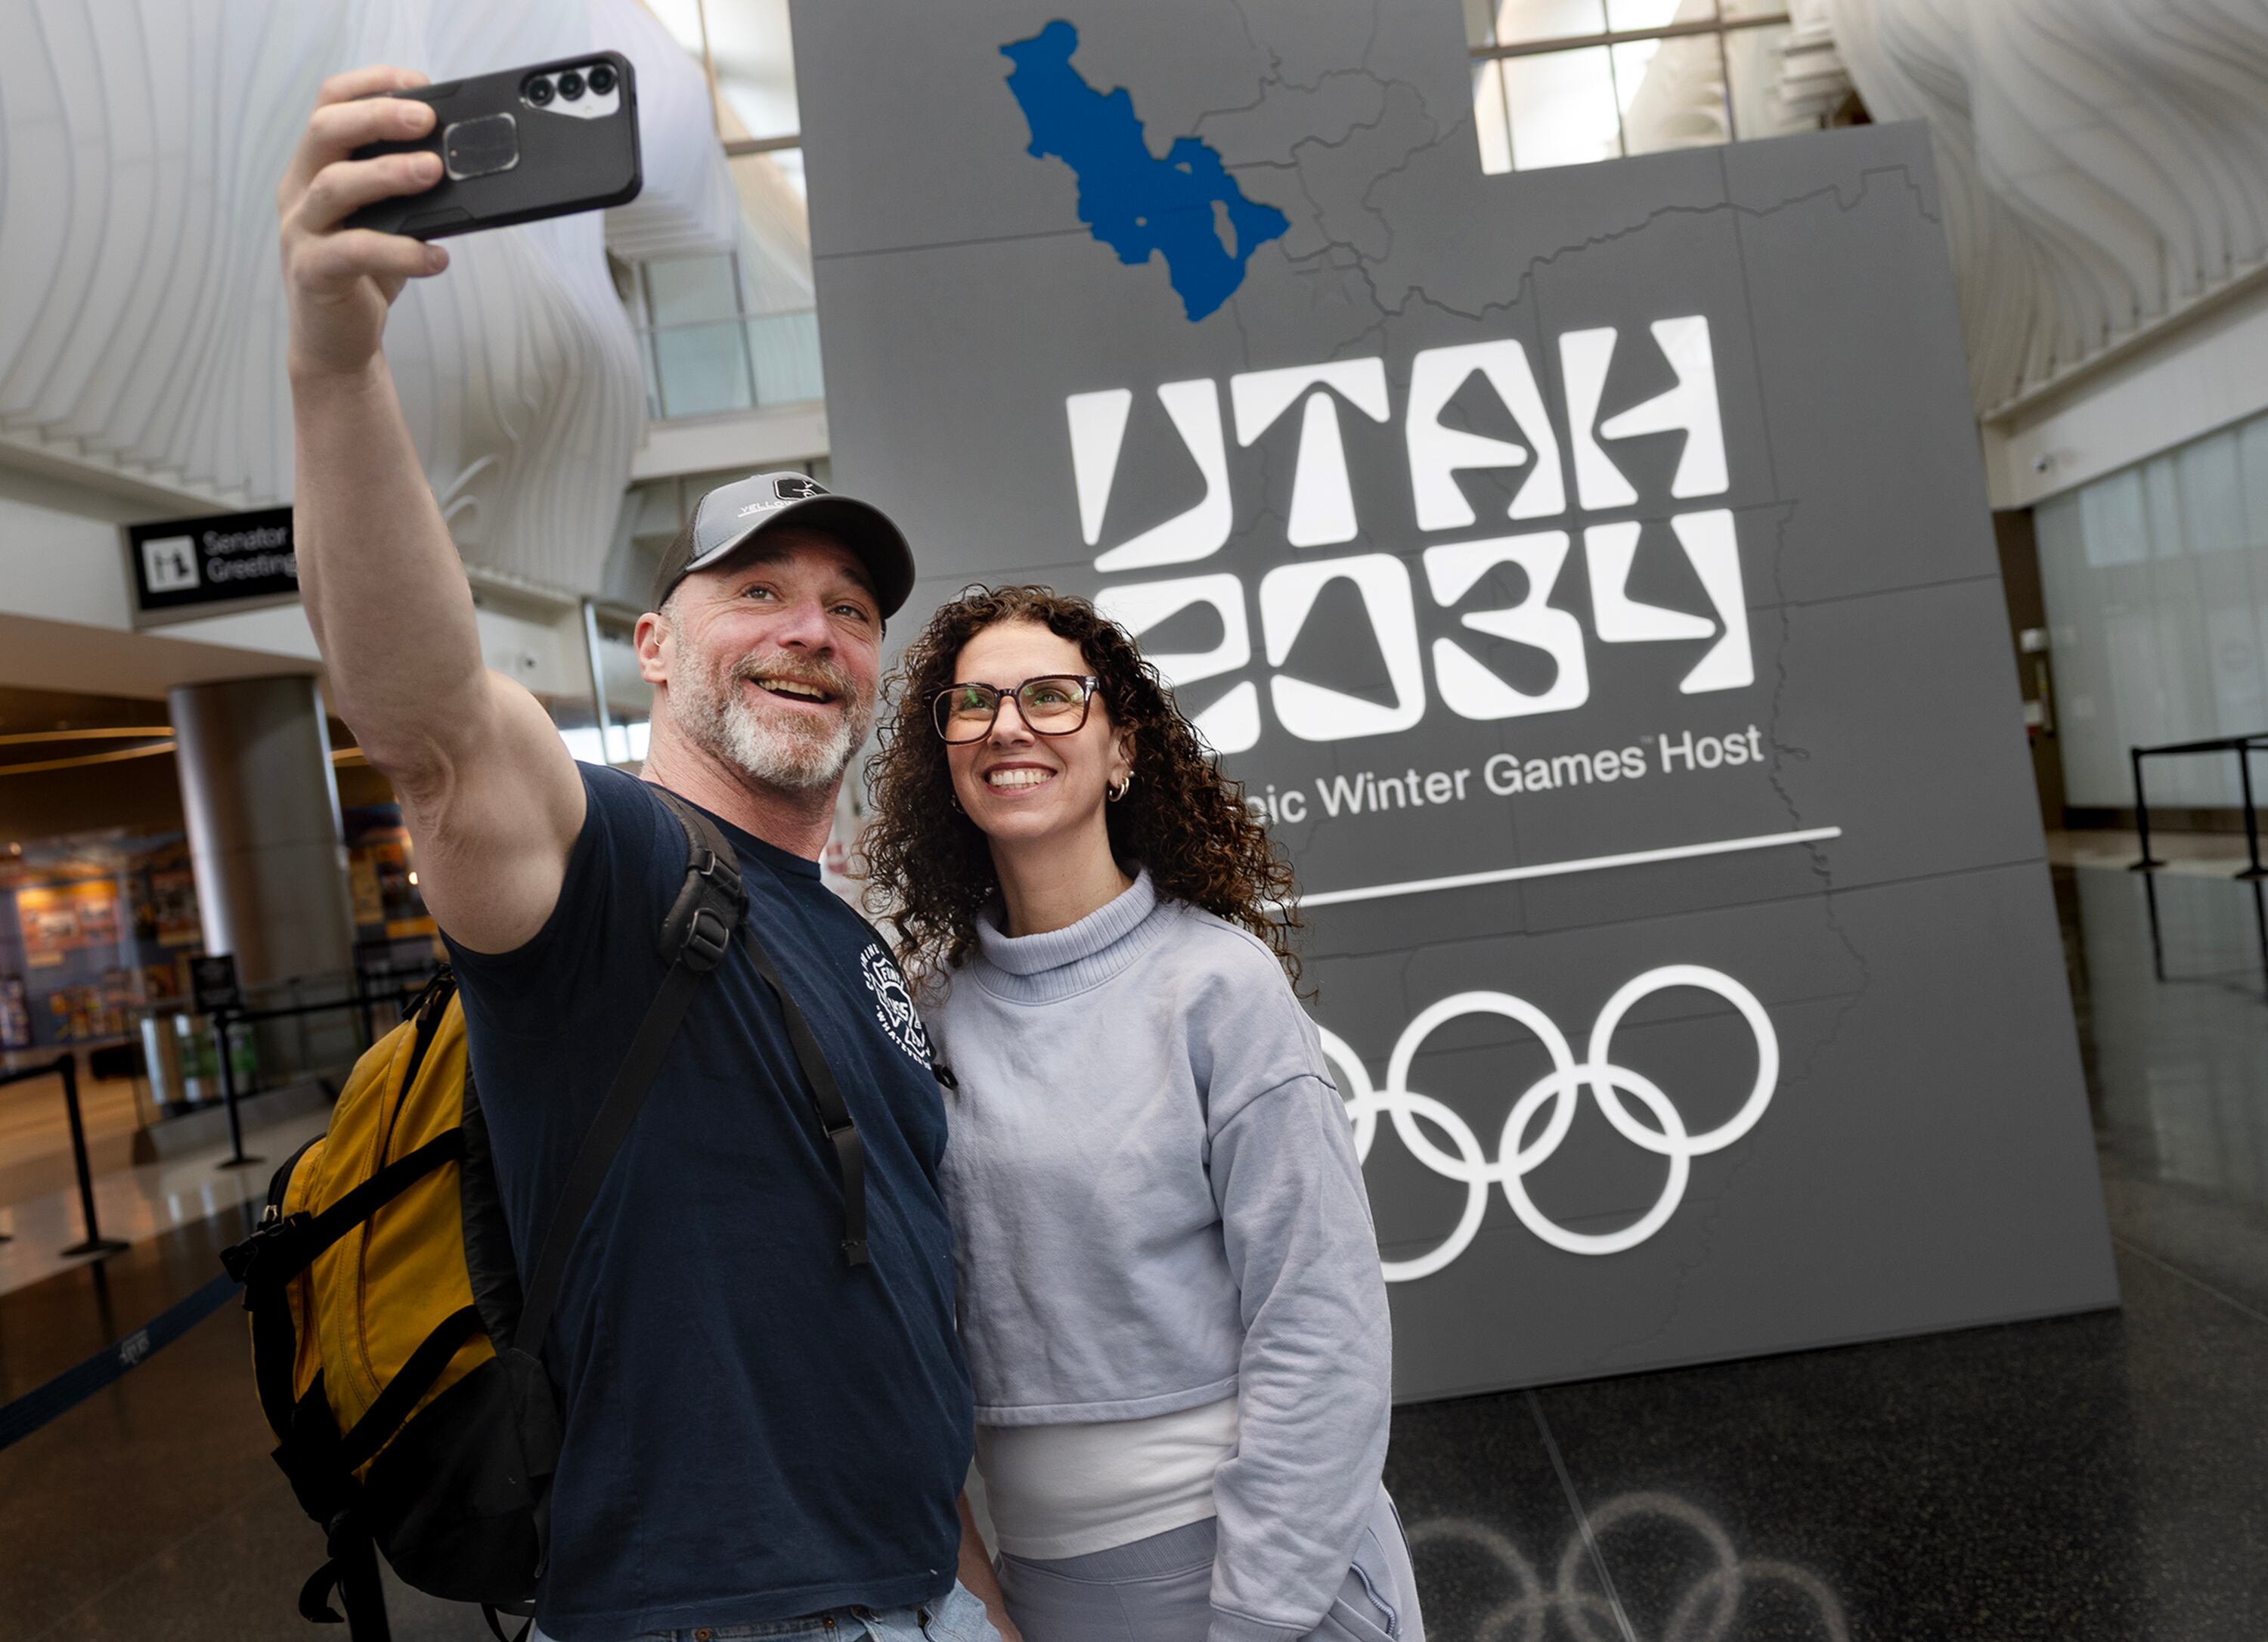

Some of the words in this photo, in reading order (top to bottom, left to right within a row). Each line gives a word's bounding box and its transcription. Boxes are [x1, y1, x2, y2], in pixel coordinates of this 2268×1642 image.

[1065, 314, 1730, 573] UTAH
[203, 527, 288, 557] Senator
[1091, 508, 1755, 757] 2034
[1315, 768, 1470, 817] Winter
[1659, 724, 1765, 773] Host
